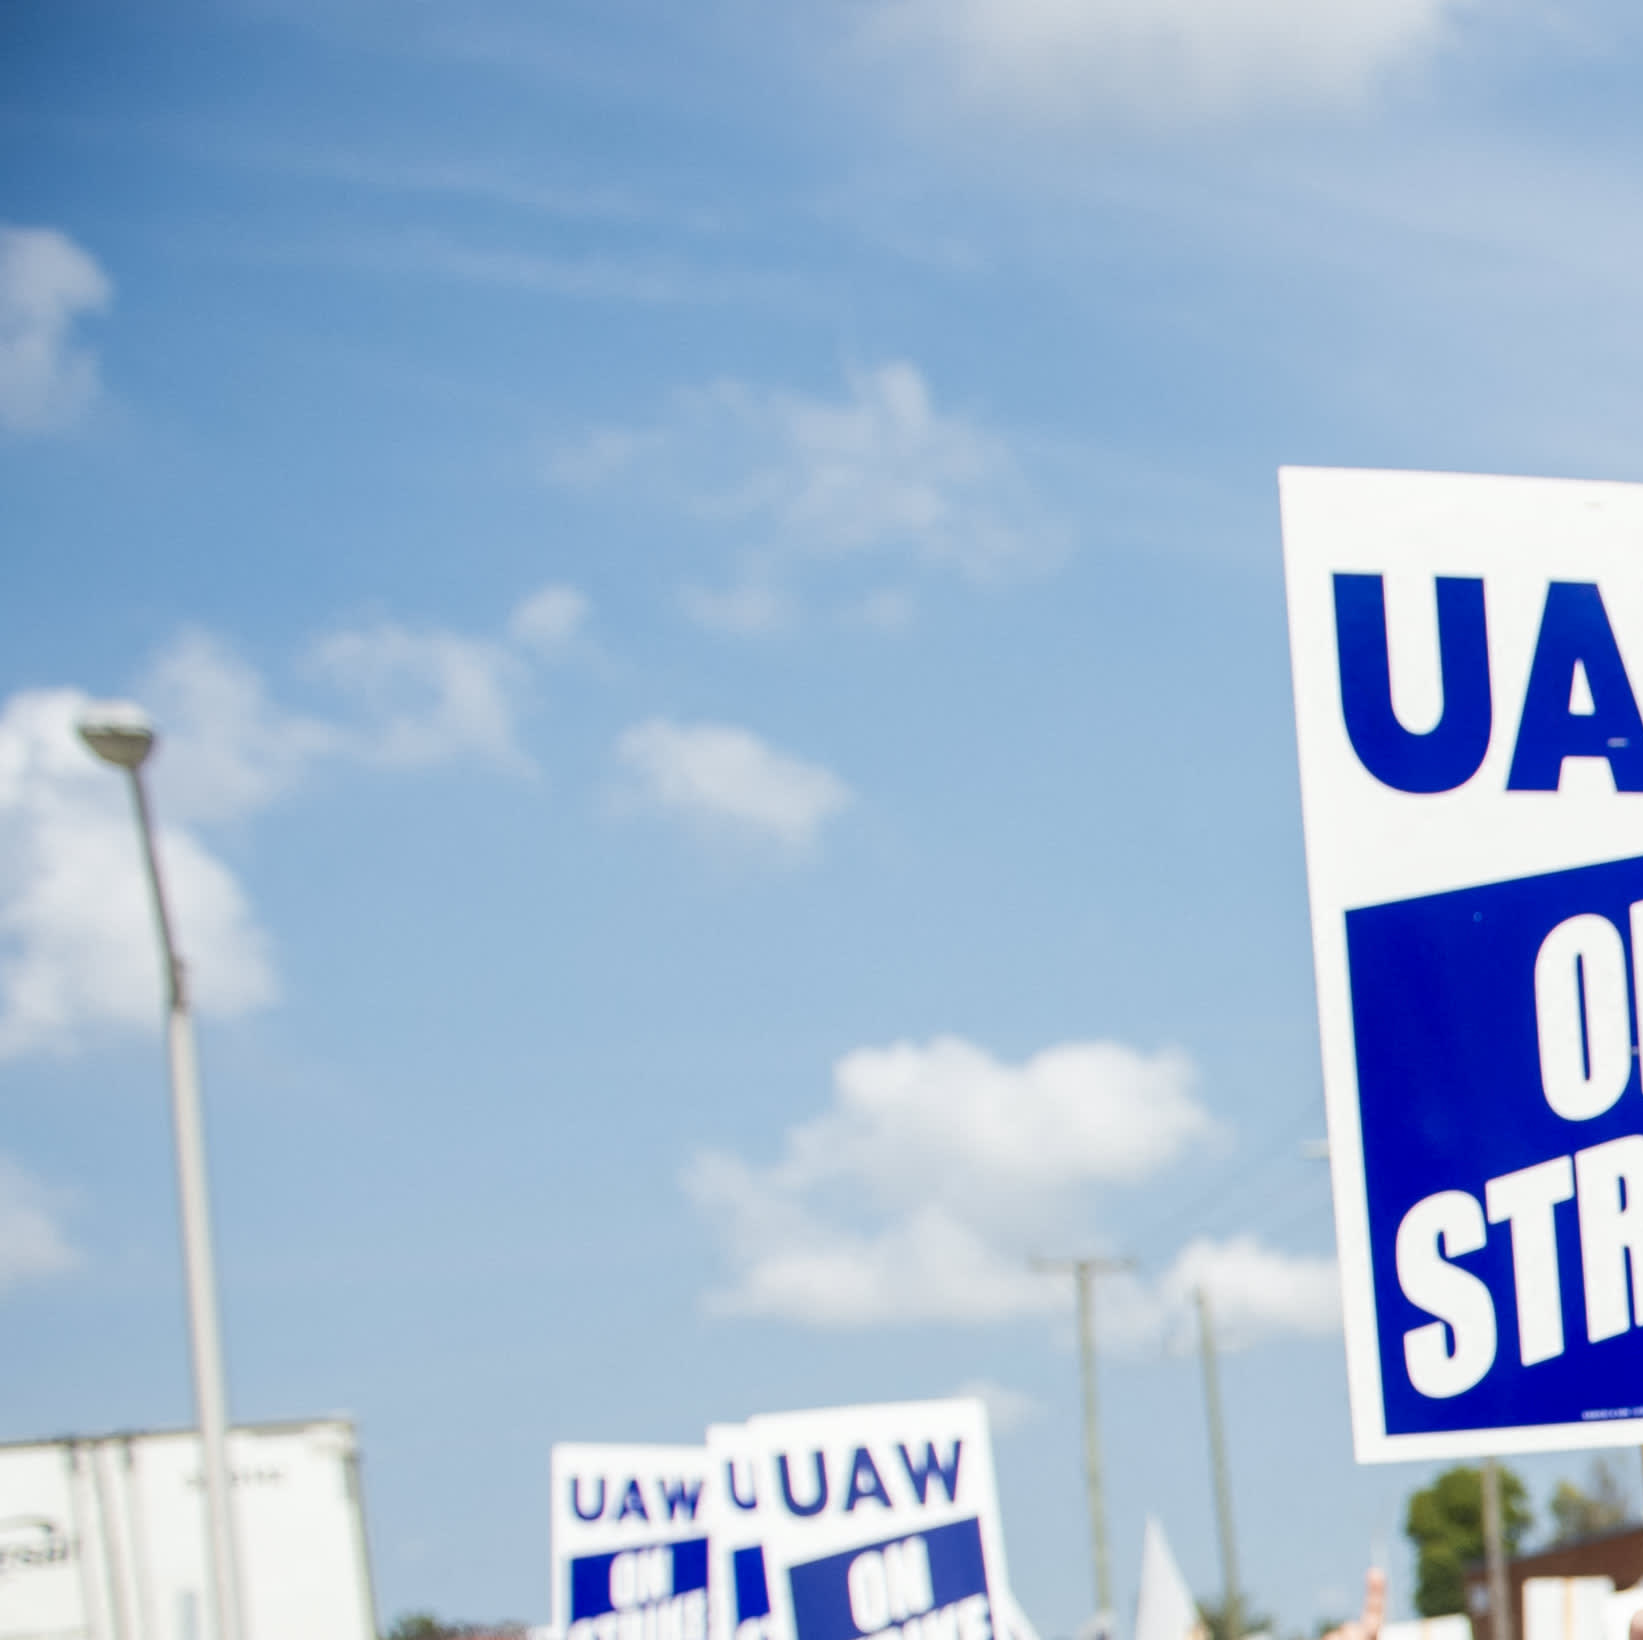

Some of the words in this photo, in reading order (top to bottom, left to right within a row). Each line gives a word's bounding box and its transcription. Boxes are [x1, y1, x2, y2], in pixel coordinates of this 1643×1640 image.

[570, 1477, 704, 1521] UAW
[778, 1440, 962, 1516] UAW
[609, 1550, 672, 1612] ON
[847, 1536, 934, 1634] ON
